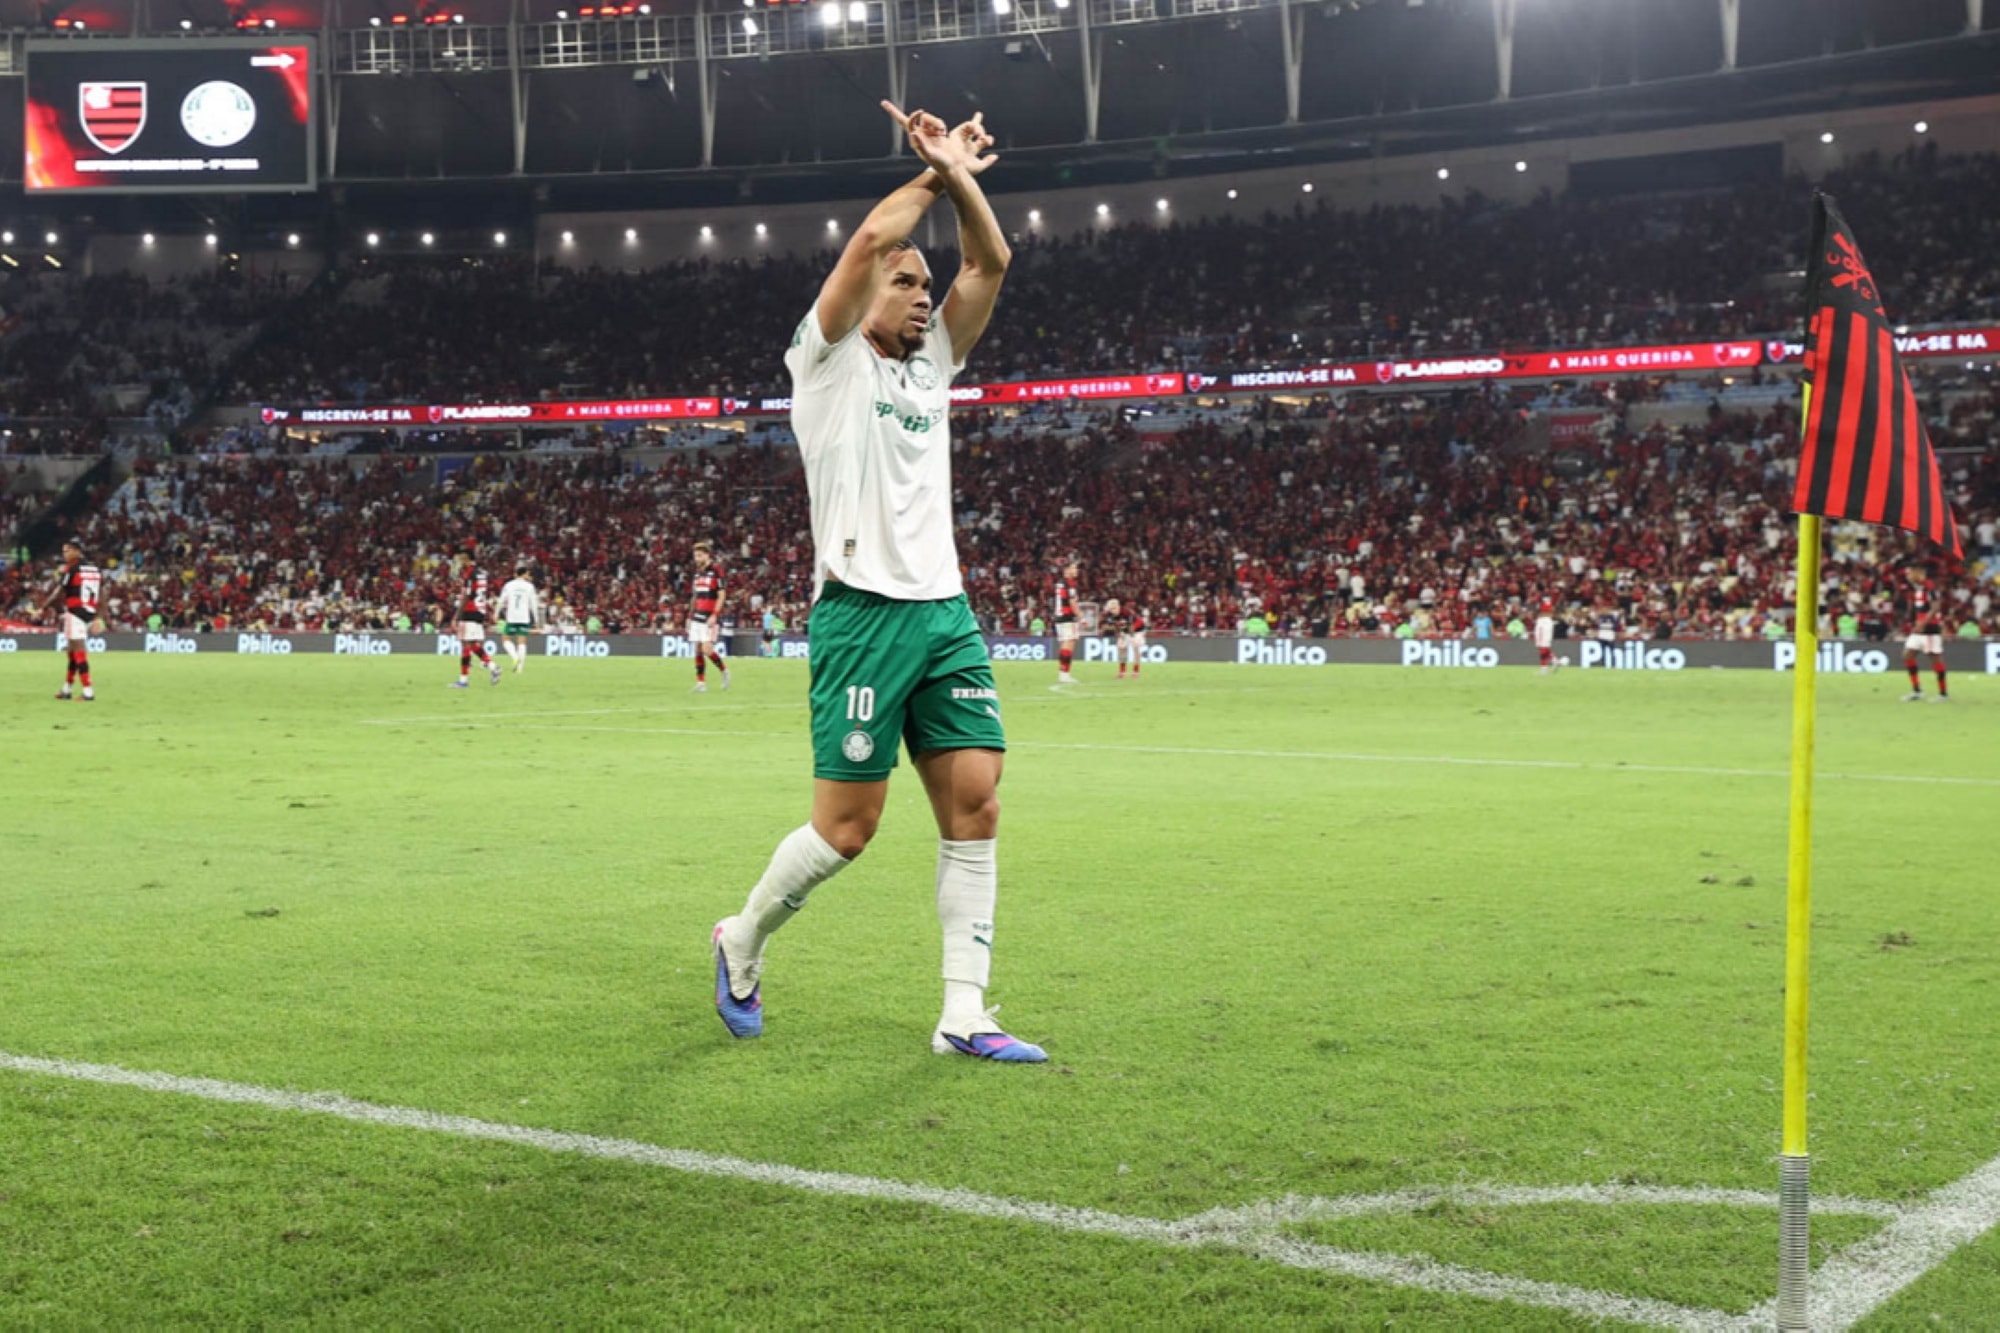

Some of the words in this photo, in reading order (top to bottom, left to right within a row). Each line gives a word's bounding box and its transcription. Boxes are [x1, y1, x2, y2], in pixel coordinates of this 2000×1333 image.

[1957, 334, 1987, 348] NA
[1394, 359, 1504, 377] FLAMENGO
[1549, 358, 1560, 368] A
[1567, 355, 1609, 368] MAIS
[1615, 350, 1694, 366] QUERIDA
[1231, 370, 1329, 386] INSCREVA-SE
[1333, 368, 1356, 381] NA
[1018, 387, 1027, 396] A
[1032, 385, 1064, 396] MAIS
[1070, 381, 1131, 395] QUERIDA
[393, 410, 412, 420] NA
[443, 406, 532, 419] FLAMENGO
[566, 407, 575, 416] A
[145, 633, 197, 652] Philco
[237, 633, 292, 653] Philco
[335, 634, 391, 655] Philco
[546, 636, 610, 657] Philco
[993, 644, 1046, 660] 2026
[1237, 639, 1327, 665] Philco
[1402, 640, 1499, 668] Philco
[1580, 640, 1686, 670] Philco
[1773, 641, 1889, 674] Pilco
[846, 685, 875, 721] 10
